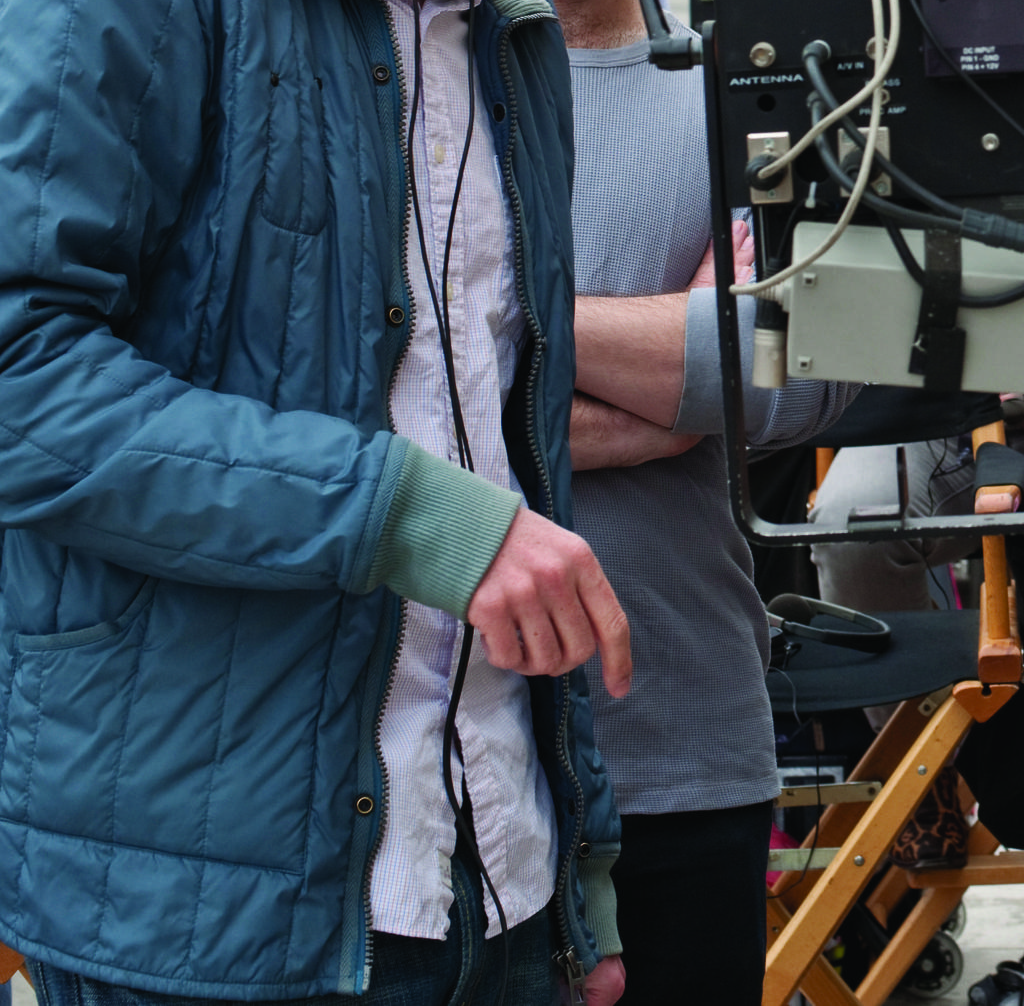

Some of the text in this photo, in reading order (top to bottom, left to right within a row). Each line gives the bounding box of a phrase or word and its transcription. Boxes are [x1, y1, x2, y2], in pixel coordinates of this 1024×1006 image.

[974, 46, 996, 54] INPUT
[837, 62, 852, 70] A/V
[729, 74, 805, 86] ANTENNA
[887, 106, 906, 114] AMP
